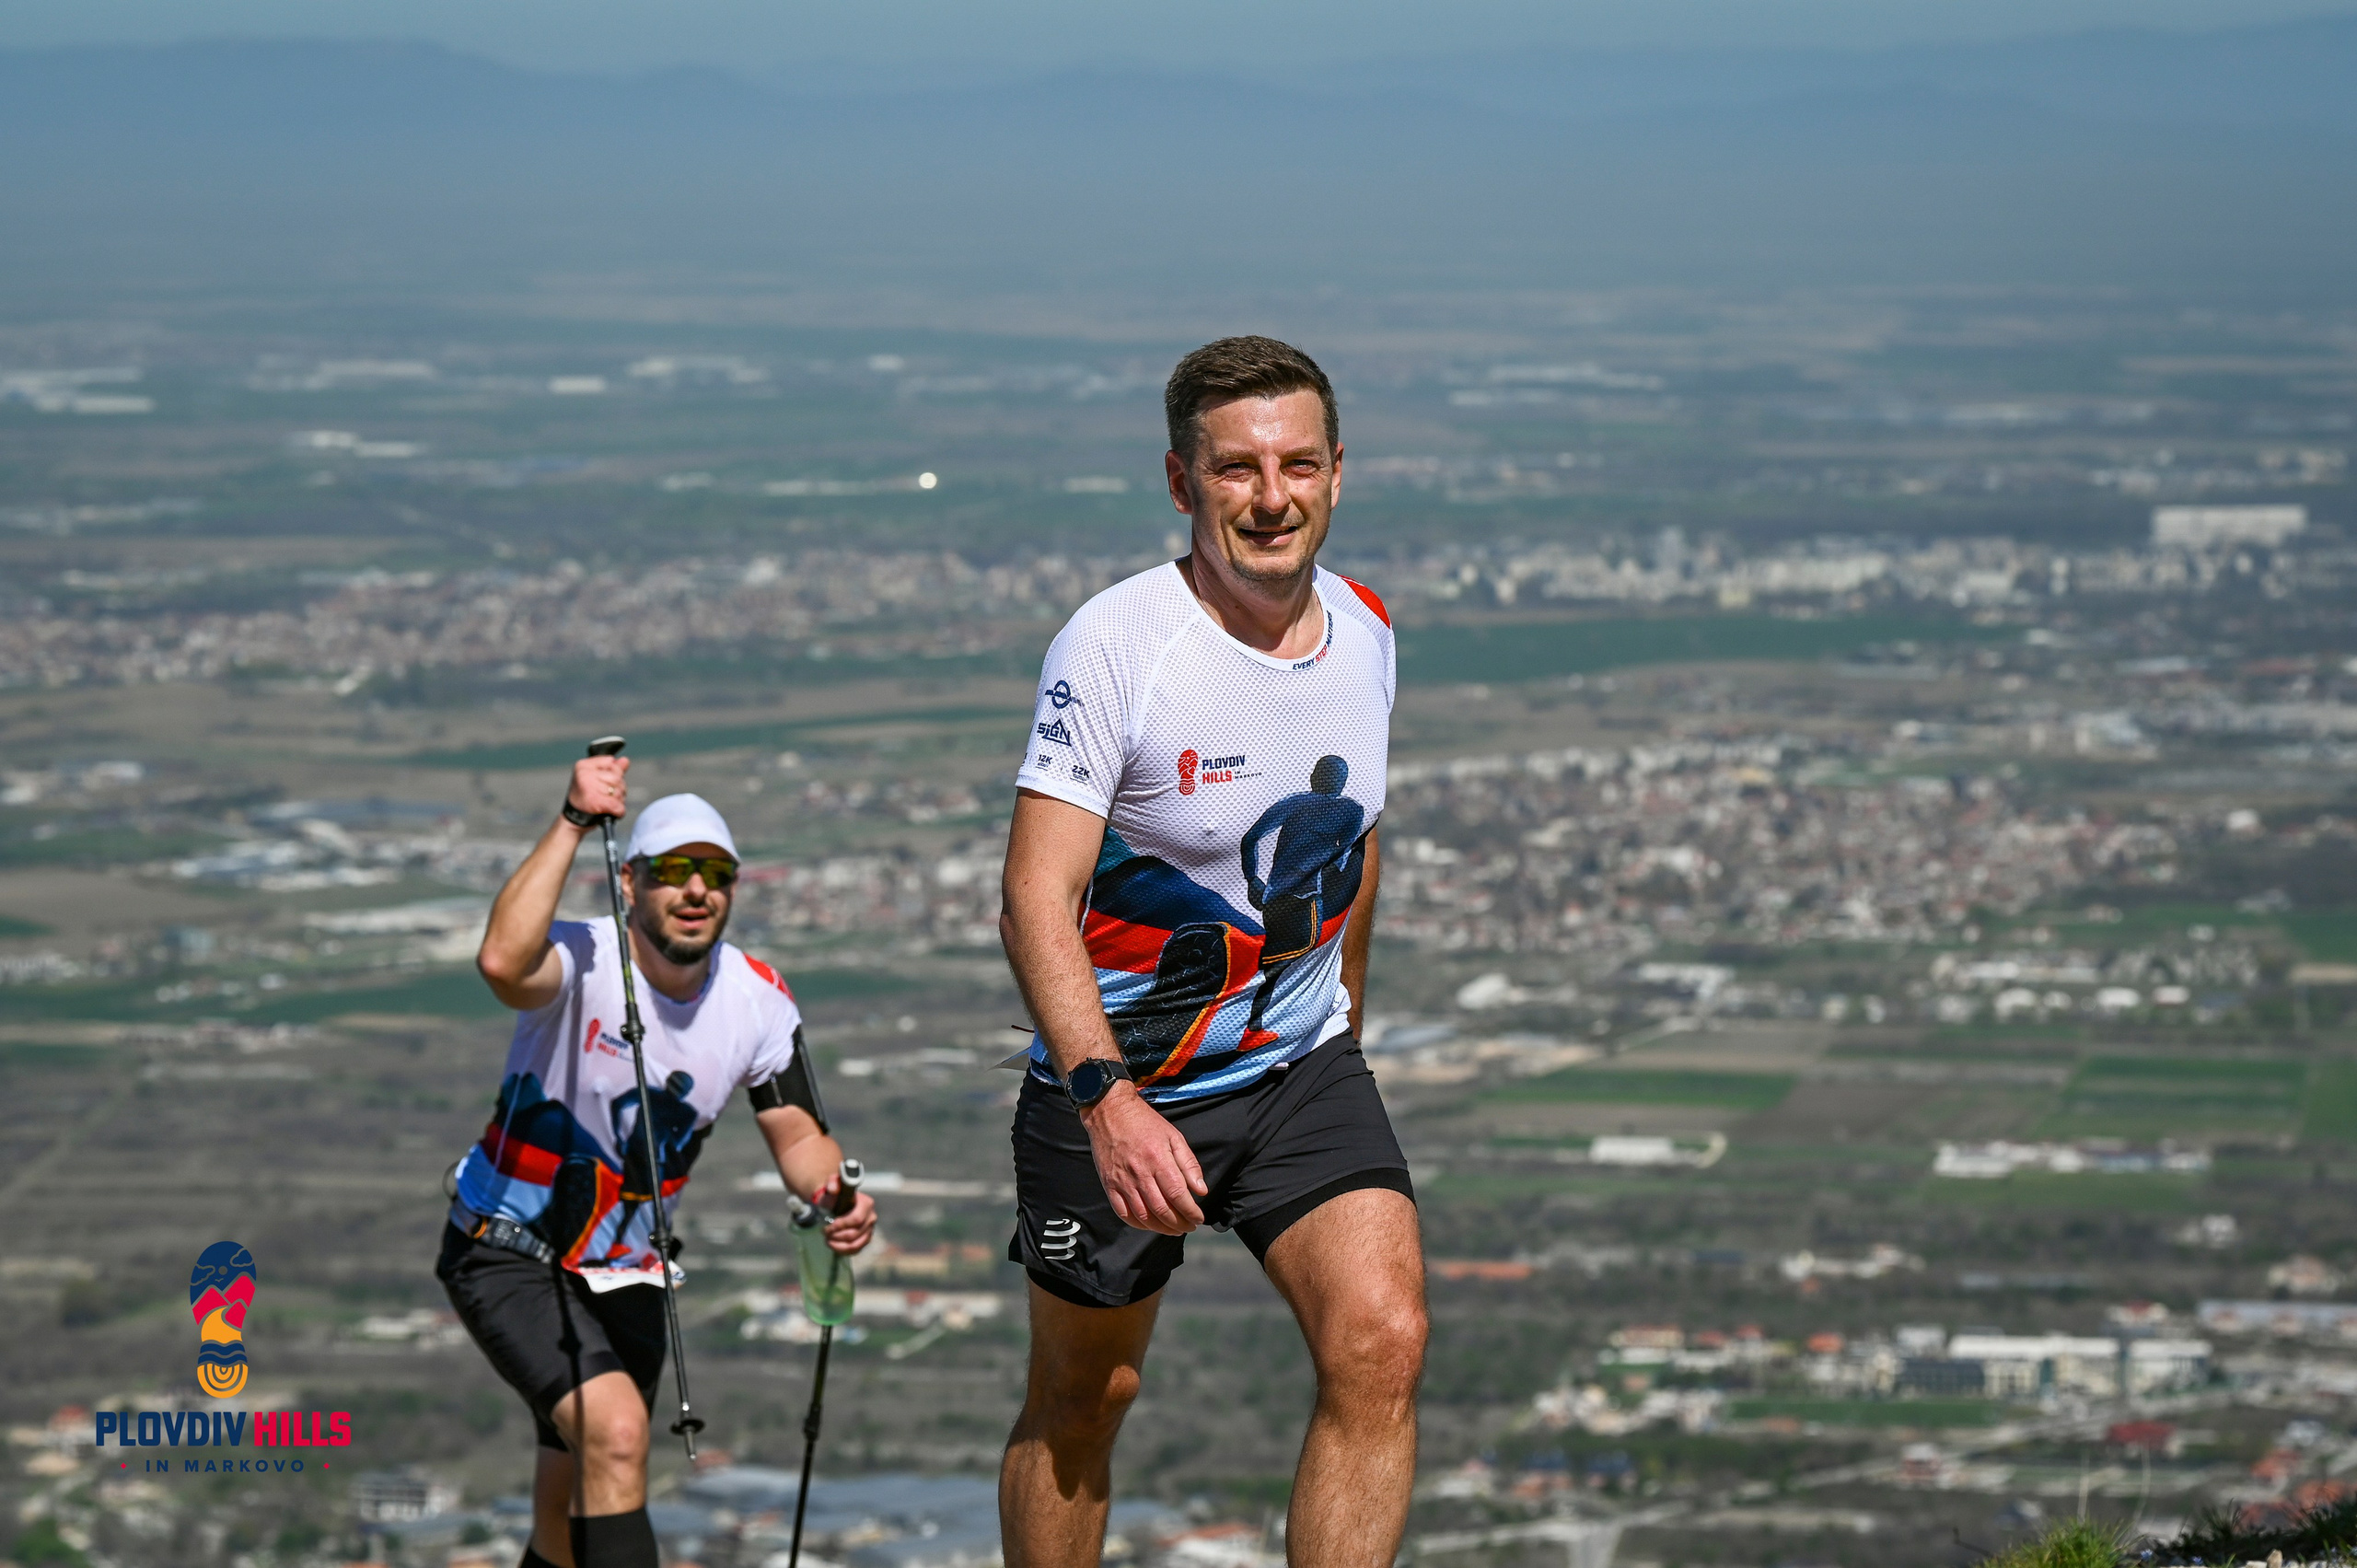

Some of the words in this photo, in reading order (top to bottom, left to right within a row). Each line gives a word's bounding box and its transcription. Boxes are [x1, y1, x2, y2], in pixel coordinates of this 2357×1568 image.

[1293, 657, 1315, 670] EVERY
[1315, 644, 1328, 662] STEP
[1038, 755, 1052, 764] 12K
[1202, 755, 1246, 771] PLOVDIV
[1072, 764, 1090, 779] 22K
[1202, 771, 1232, 784] HILLS
